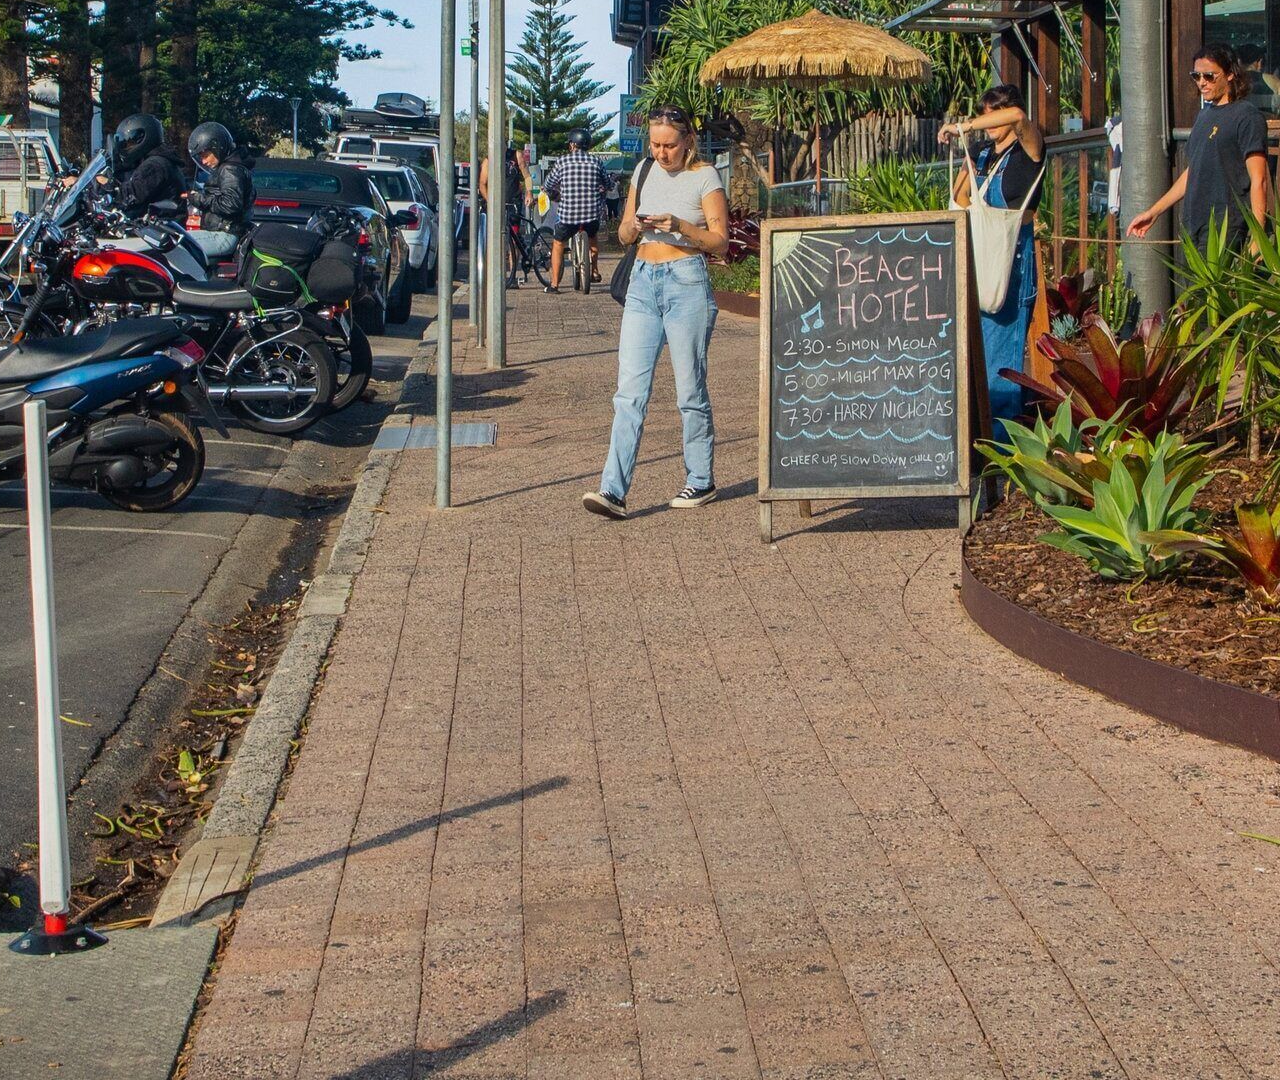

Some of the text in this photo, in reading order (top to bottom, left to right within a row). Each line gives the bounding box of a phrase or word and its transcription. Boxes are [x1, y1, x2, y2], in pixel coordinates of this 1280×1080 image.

[835, 247, 943, 288] BEACH
[837, 283, 948, 330] HOTEL
[887, 335, 938, 351] MEOLA
[884, 365, 915, 381] MAX
[918, 362, 951, 380] FOG
[834, 402, 878, 422] HARRY
[882, 398, 954, 420] NICHOLAS
[780, 453, 820, 467] CHEER
[909, 453, 933, 465] CHILL
[934, 450, 955, 464] OUT
